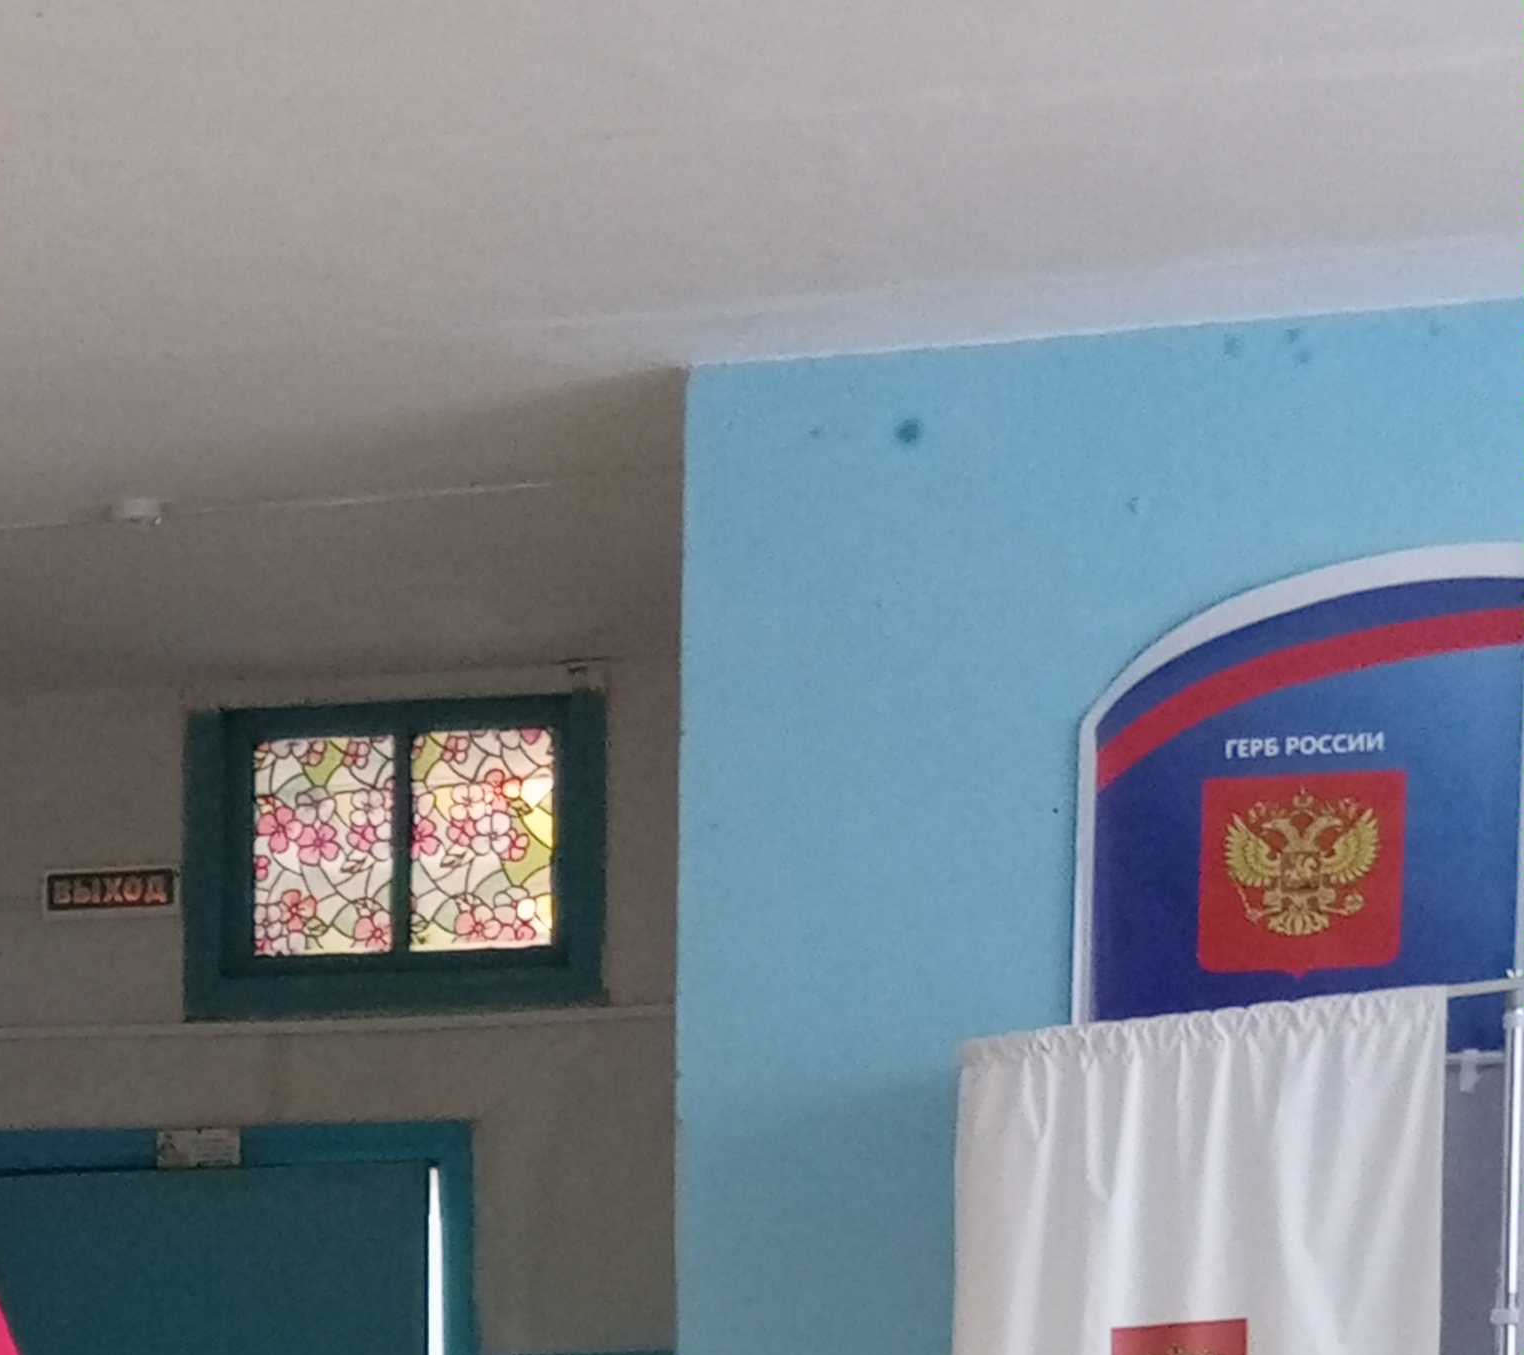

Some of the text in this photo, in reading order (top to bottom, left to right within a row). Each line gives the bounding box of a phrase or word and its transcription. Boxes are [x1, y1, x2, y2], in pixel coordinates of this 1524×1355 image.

[1225, 731, 1385, 760] ГЕРБ РОССИИ
[53, 876, 168, 905] ВЫХОД
